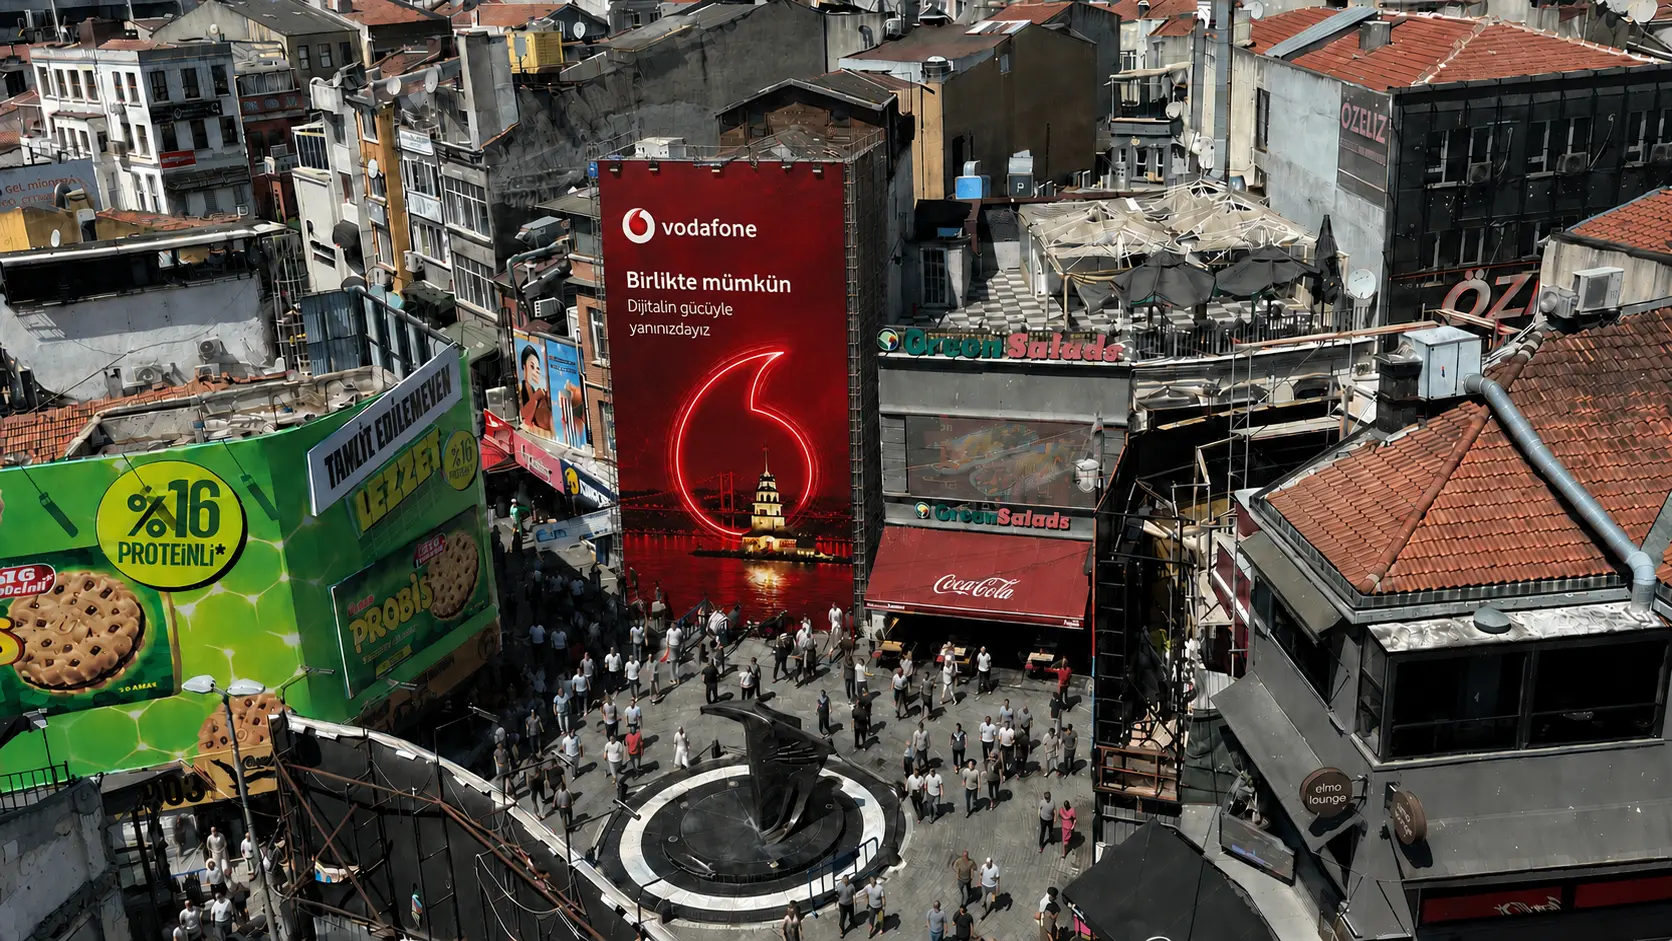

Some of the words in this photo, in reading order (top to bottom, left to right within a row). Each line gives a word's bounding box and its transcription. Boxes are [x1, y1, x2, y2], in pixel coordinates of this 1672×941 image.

[661, 219, 758, 238] vodafone
[626, 271, 698, 291] Birlikte
[702, 273, 792, 293] mümkün
[627, 299, 677, 316] Dijitalin
[680, 301, 734, 318] gücüyle
[629, 321, 711, 339] yanınızdayız
[1007, 331, 1125, 362] Salads
[355, 426, 442, 534] LEZZET
[127, 479, 221, 539] %16
[996, 507, 1071, 531] Salads
[933, 573, 1022, 600] Coca-Cola
[1315, 783, 1342, 794] elmo
[1309, 795, 1347, 806] lounge
